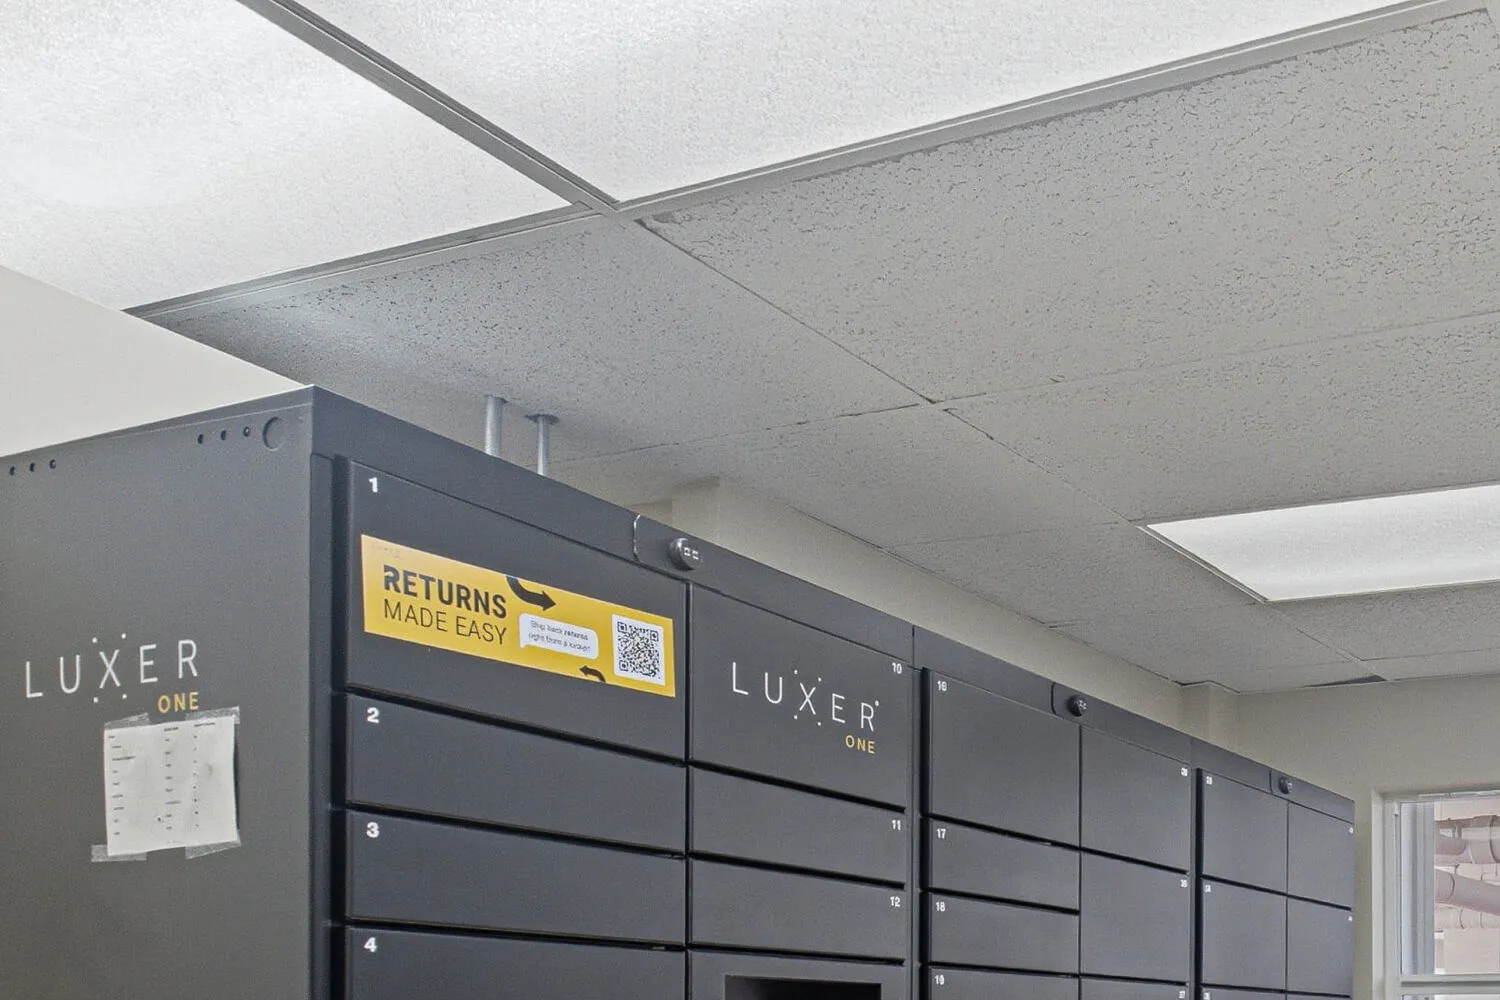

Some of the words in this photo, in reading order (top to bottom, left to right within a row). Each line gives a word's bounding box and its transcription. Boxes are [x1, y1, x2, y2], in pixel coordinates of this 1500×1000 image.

[368, 477, 378, 493] 1
[383, 565, 507, 618] RETURNS
[384, 599, 448, 632] MADE
[456, 617, 508, 645] EASY
[564, 630, 588, 641] returns
[26, 638, 198, 699] LUXER
[891, 662, 903, 675] 10
[158, 691, 199, 714] ONE
[732, 661, 875, 731] LUXER
[366, 707, 380, 724] 2
[845, 735, 875, 754] ONE
[366, 821, 380, 838] 3
[891, 819, 901, 831] 11
[936, 828, 946, 839] 17
[890, 896, 901, 908] 12
[363, 937, 377, 953] 4
